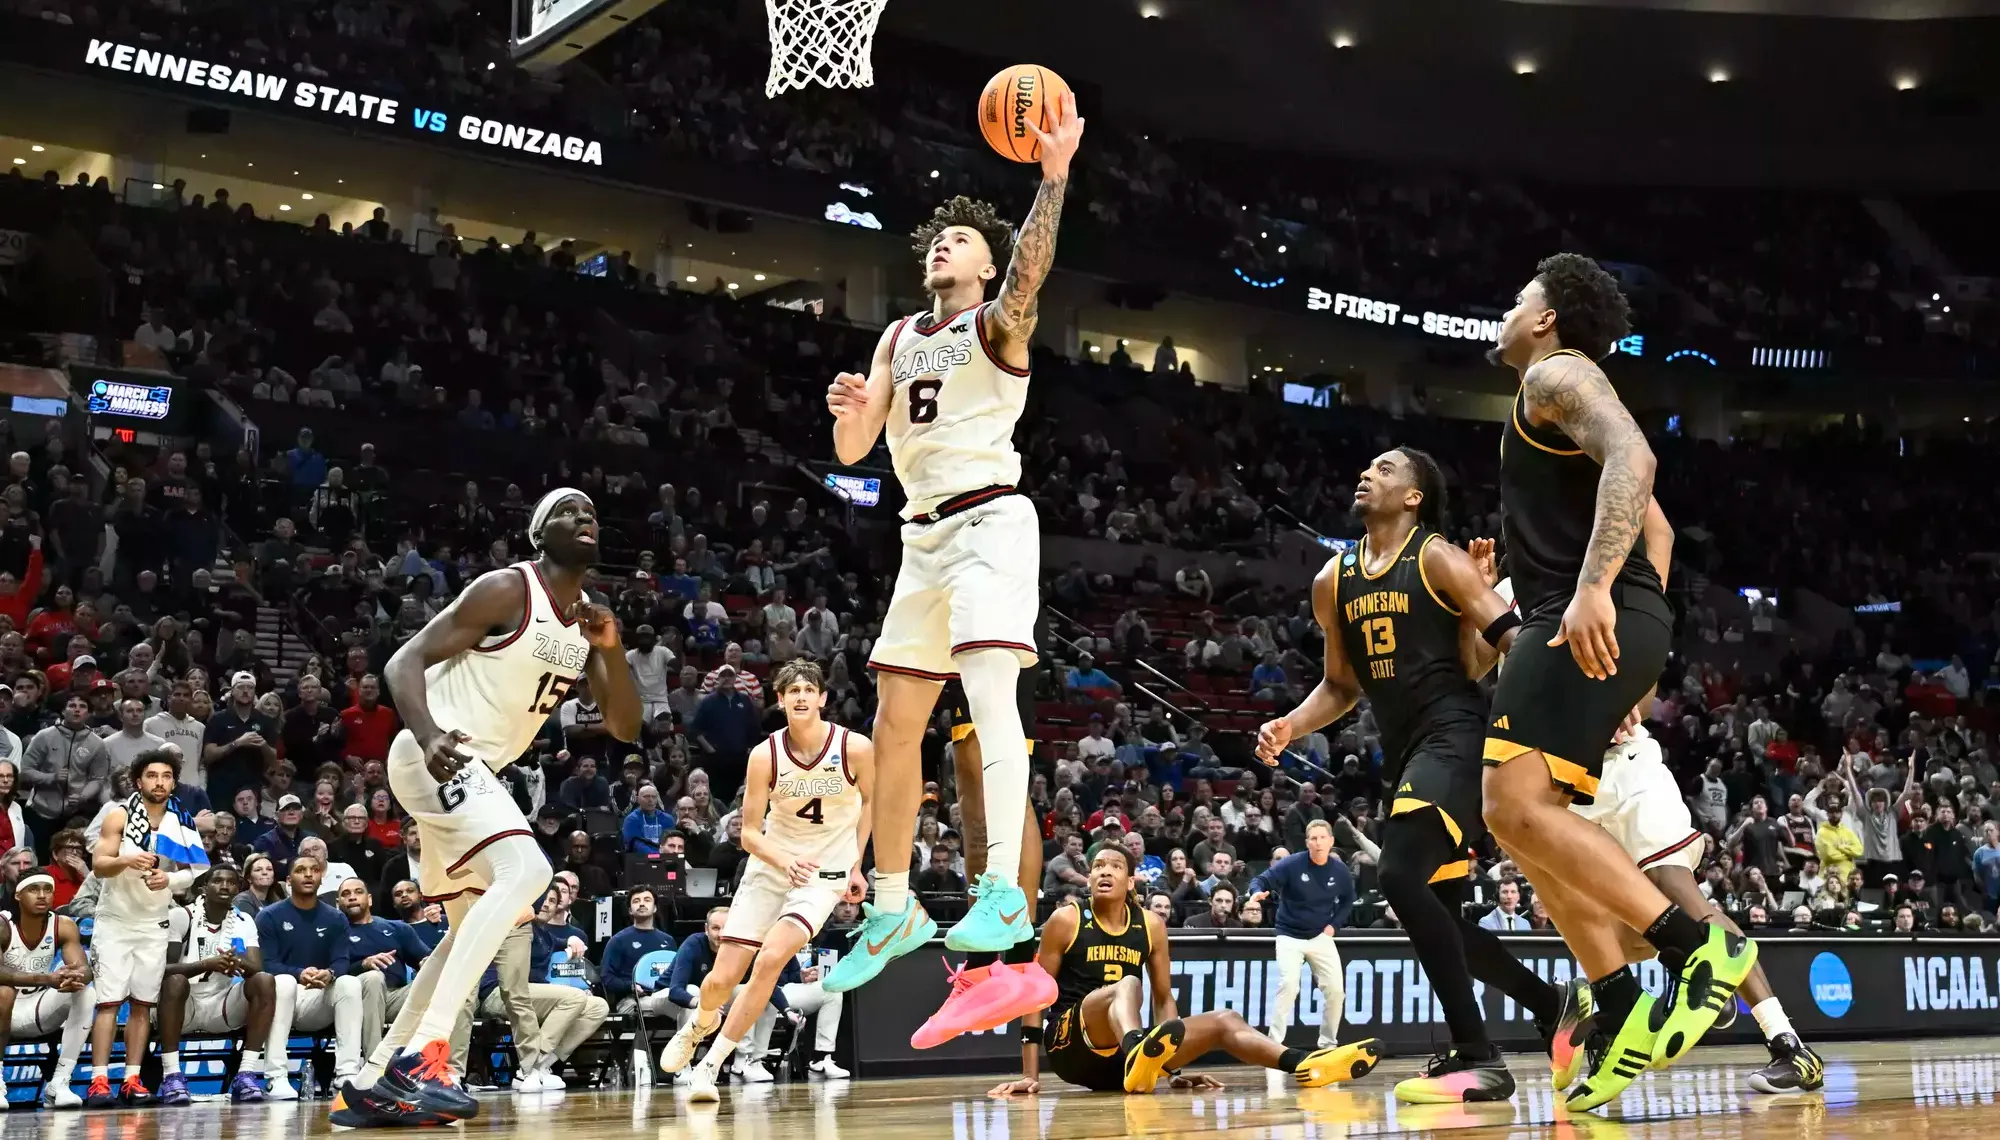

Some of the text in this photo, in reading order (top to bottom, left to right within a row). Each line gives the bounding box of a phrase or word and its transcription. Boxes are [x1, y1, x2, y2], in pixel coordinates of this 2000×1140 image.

[85, 38, 602, 165] KENNESAW STATE VS GONZAGA
[1014, 75, 1035, 139] Wilson
[1334, 293, 1504, 342] FIRST SECON
[893, 338, 972, 385] ZAGS
[106, 384, 148, 400] MARCH
[110, 396, 167, 414] MADNESS
[909, 379, 943, 425] 8
[1345, 591, 1409, 625] KENNESAW
[532, 632, 589, 672] ZAGS
[1361, 617, 1396, 656] 13
[1370, 658, 1395, 680] STATE
[527, 671, 578, 715] 15
[778, 776, 843, 798] ZAGS
[796, 797, 824, 825] 4
[1086, 944, 1142, 967] KENNESAW
[1815, 983, 1852, 1001] NCAA
